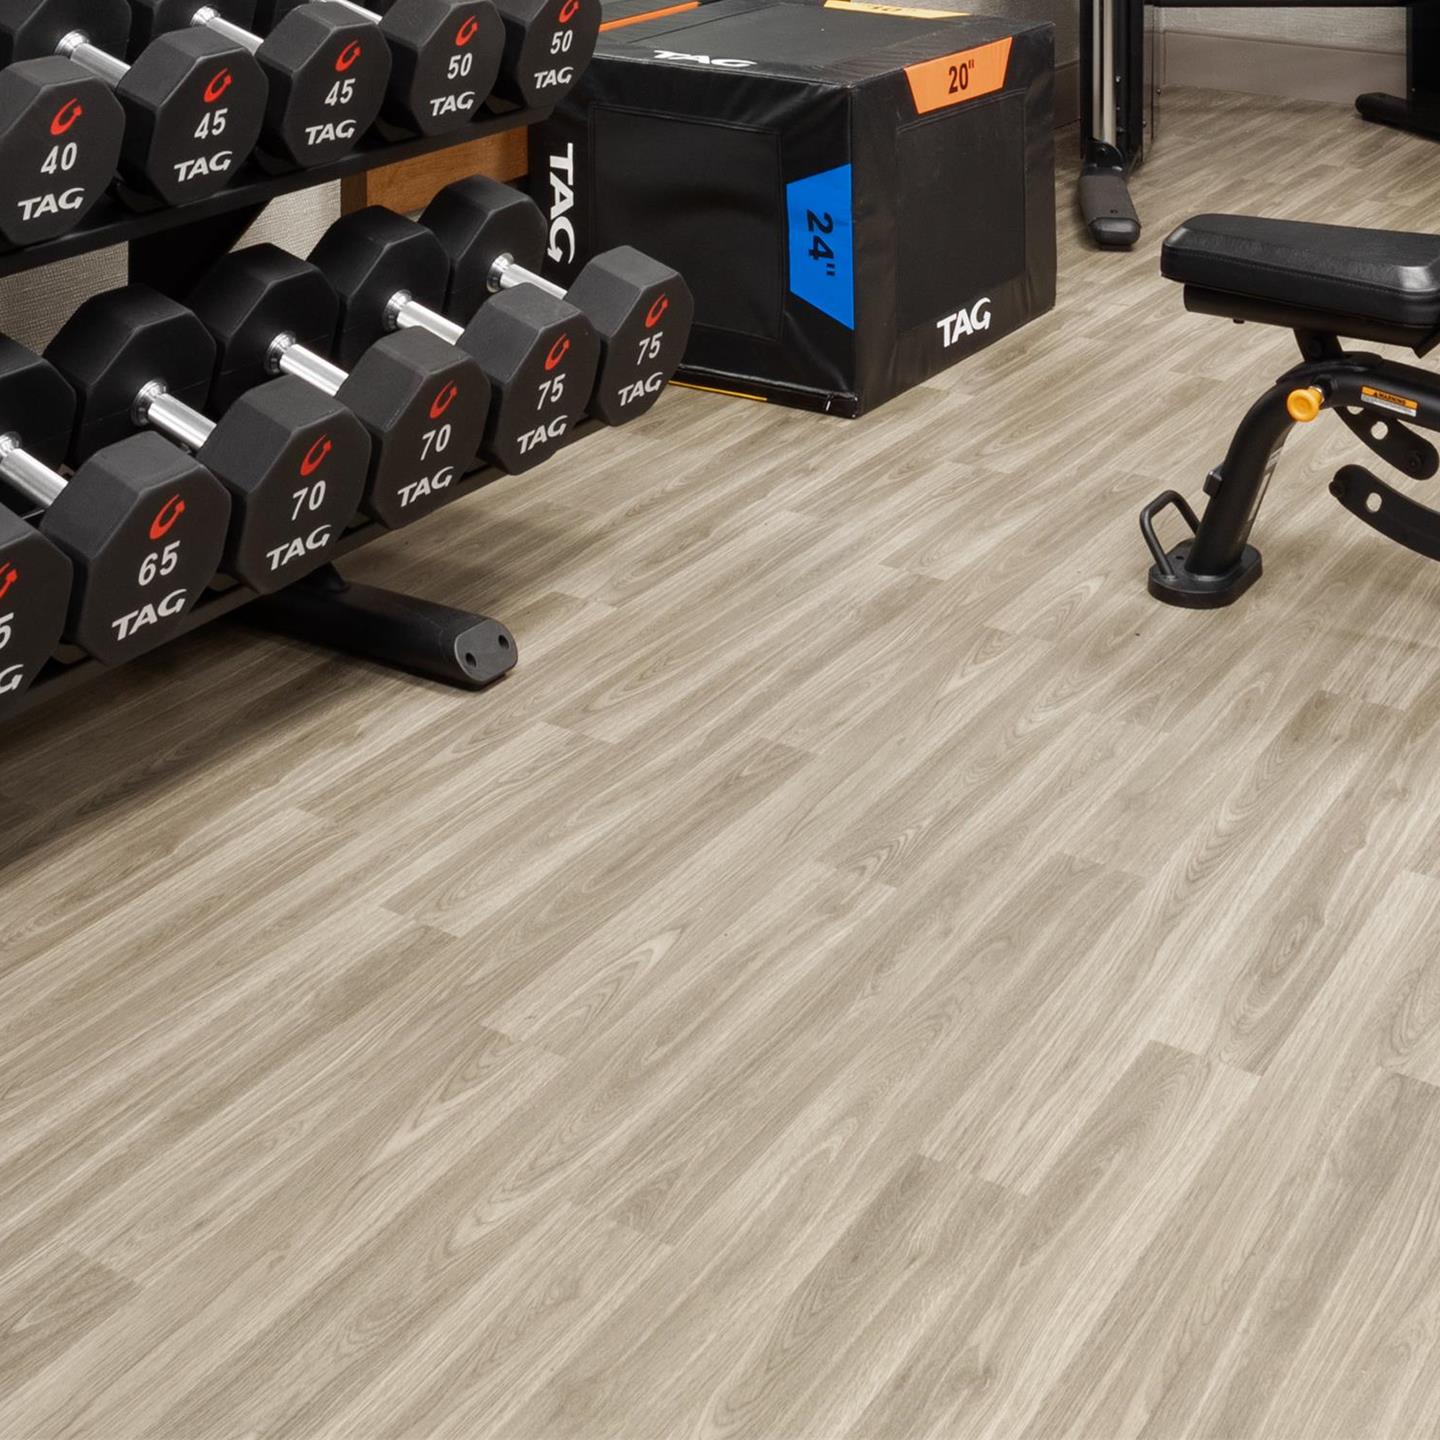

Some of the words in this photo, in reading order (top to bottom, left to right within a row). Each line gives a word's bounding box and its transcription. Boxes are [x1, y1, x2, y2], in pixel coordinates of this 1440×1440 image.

[550, 29, 573, 55] 50
[447, 52, 473, 80] 50
[533, 66, 574, 89] TAG
[948, 58, 975, 94] 20"
[324, 78, 356, 106] 45
[429, 91, 475, 117] TAG
[193, 107, 228, 140] 45
[305, 119, 357, 146] TAG
[40, 142, 78, 175] 40
[173, 150, 233, 182] TAG
[17, 187, 85, 221] TAG
[547, 142, 575, 264] TAG
[806, 208, 836, 277] 24"
[936, 296, 992, 348] TAG
[636, 331, 663, 365] 75
[537, 373, 566, 410] 75
[617, 370, 664, 408] TAG
[420, 423, 451, 461] 70
[515, 413, 568, 455] TAG
[291, 480, 326, 521] 70
[397, 466, 454, 507] TAG
[137, 539, 182, 588] 65
[266, 524, 331, 571] TAG
[110, 587, 188, 642] TAG
